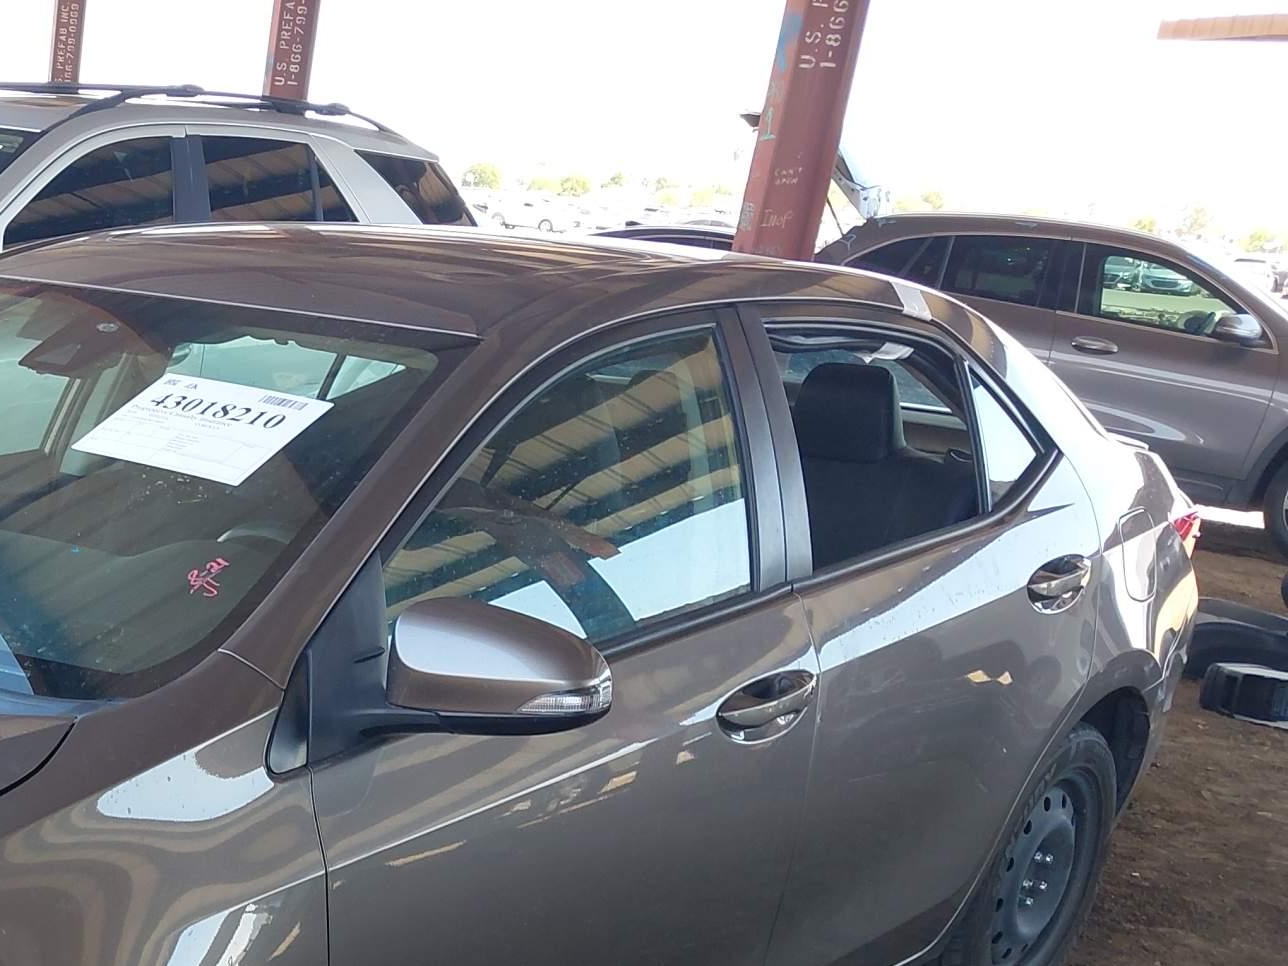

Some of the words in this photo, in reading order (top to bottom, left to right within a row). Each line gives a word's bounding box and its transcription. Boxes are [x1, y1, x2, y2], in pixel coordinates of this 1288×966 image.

[56, 27, 67, 69] PREFAB
[798, 24, 825, 69] U.S.
[150, 393, 286, 429] 43018210
